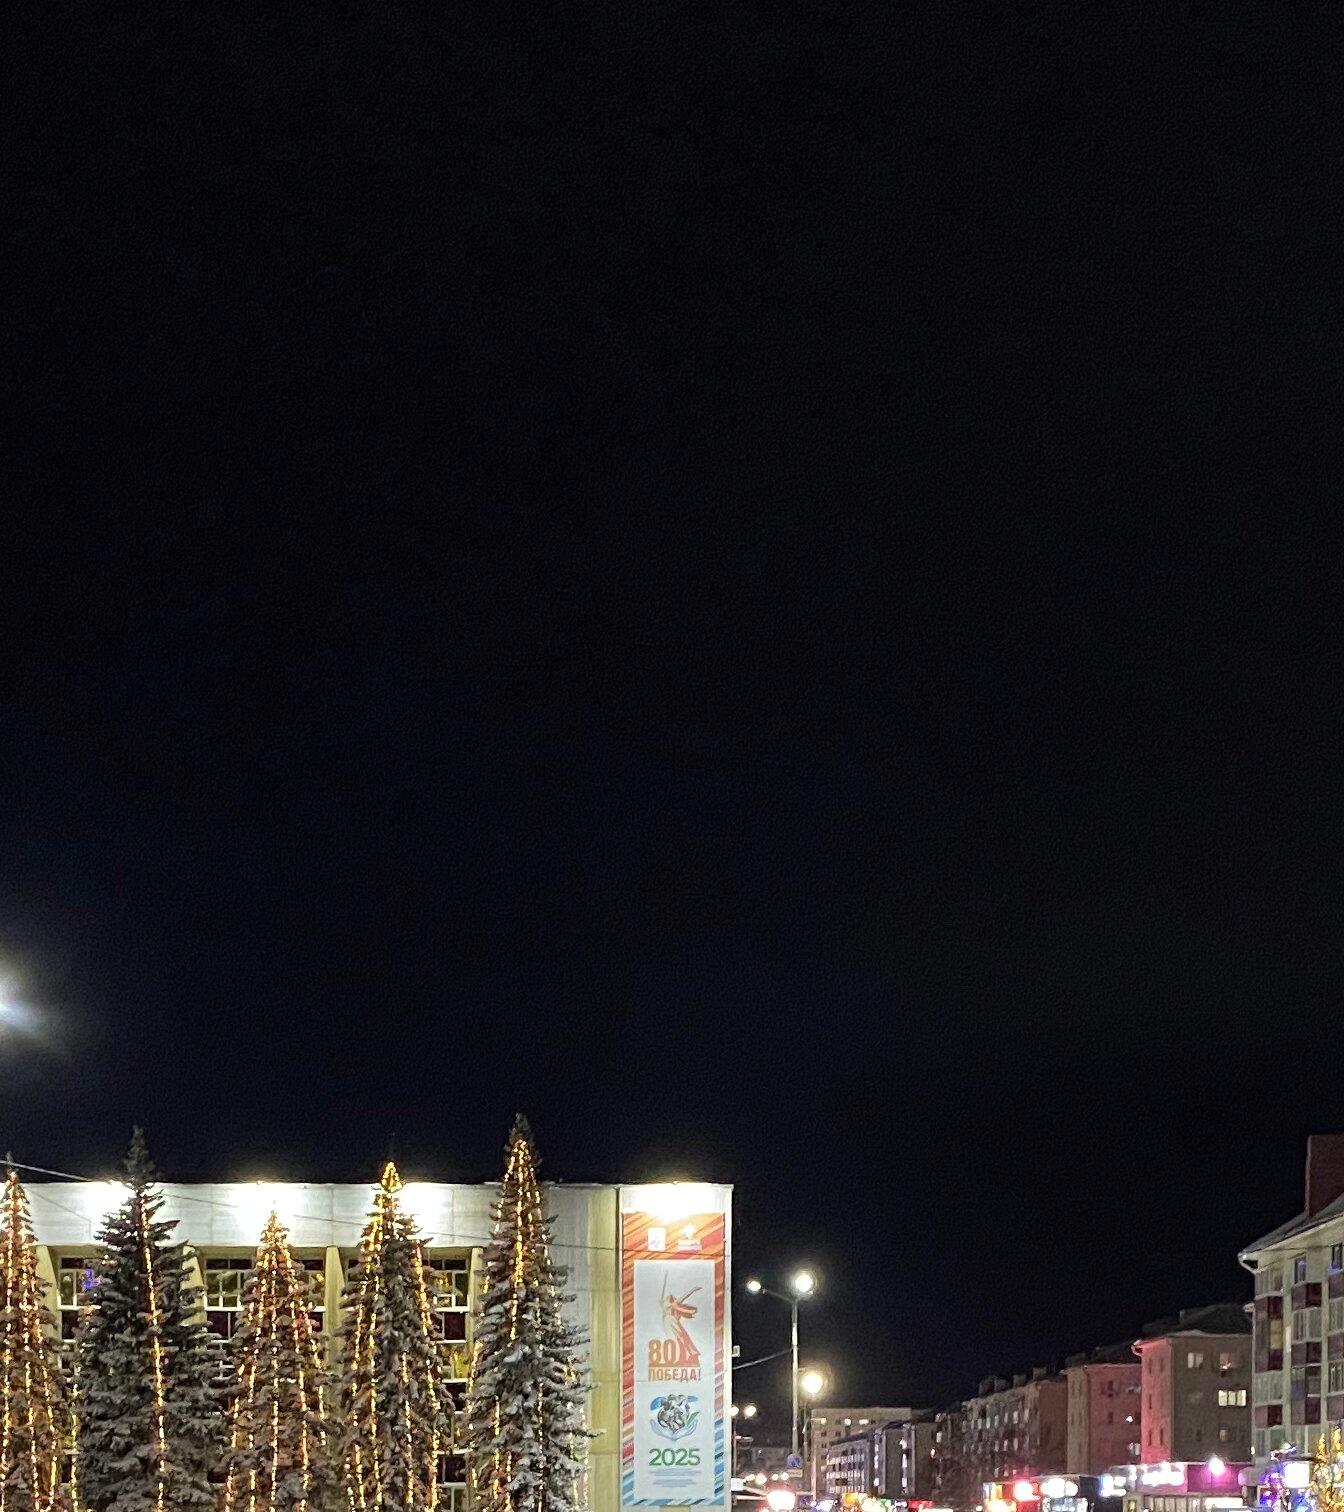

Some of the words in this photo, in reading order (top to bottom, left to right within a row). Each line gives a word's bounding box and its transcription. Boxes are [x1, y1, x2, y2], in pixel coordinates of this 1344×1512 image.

[648, 1339, 676, 1364] 80
[648, 1368, 701, 1382] ПОБЕДА!
[648, 1448, 701, 1466] 2025
